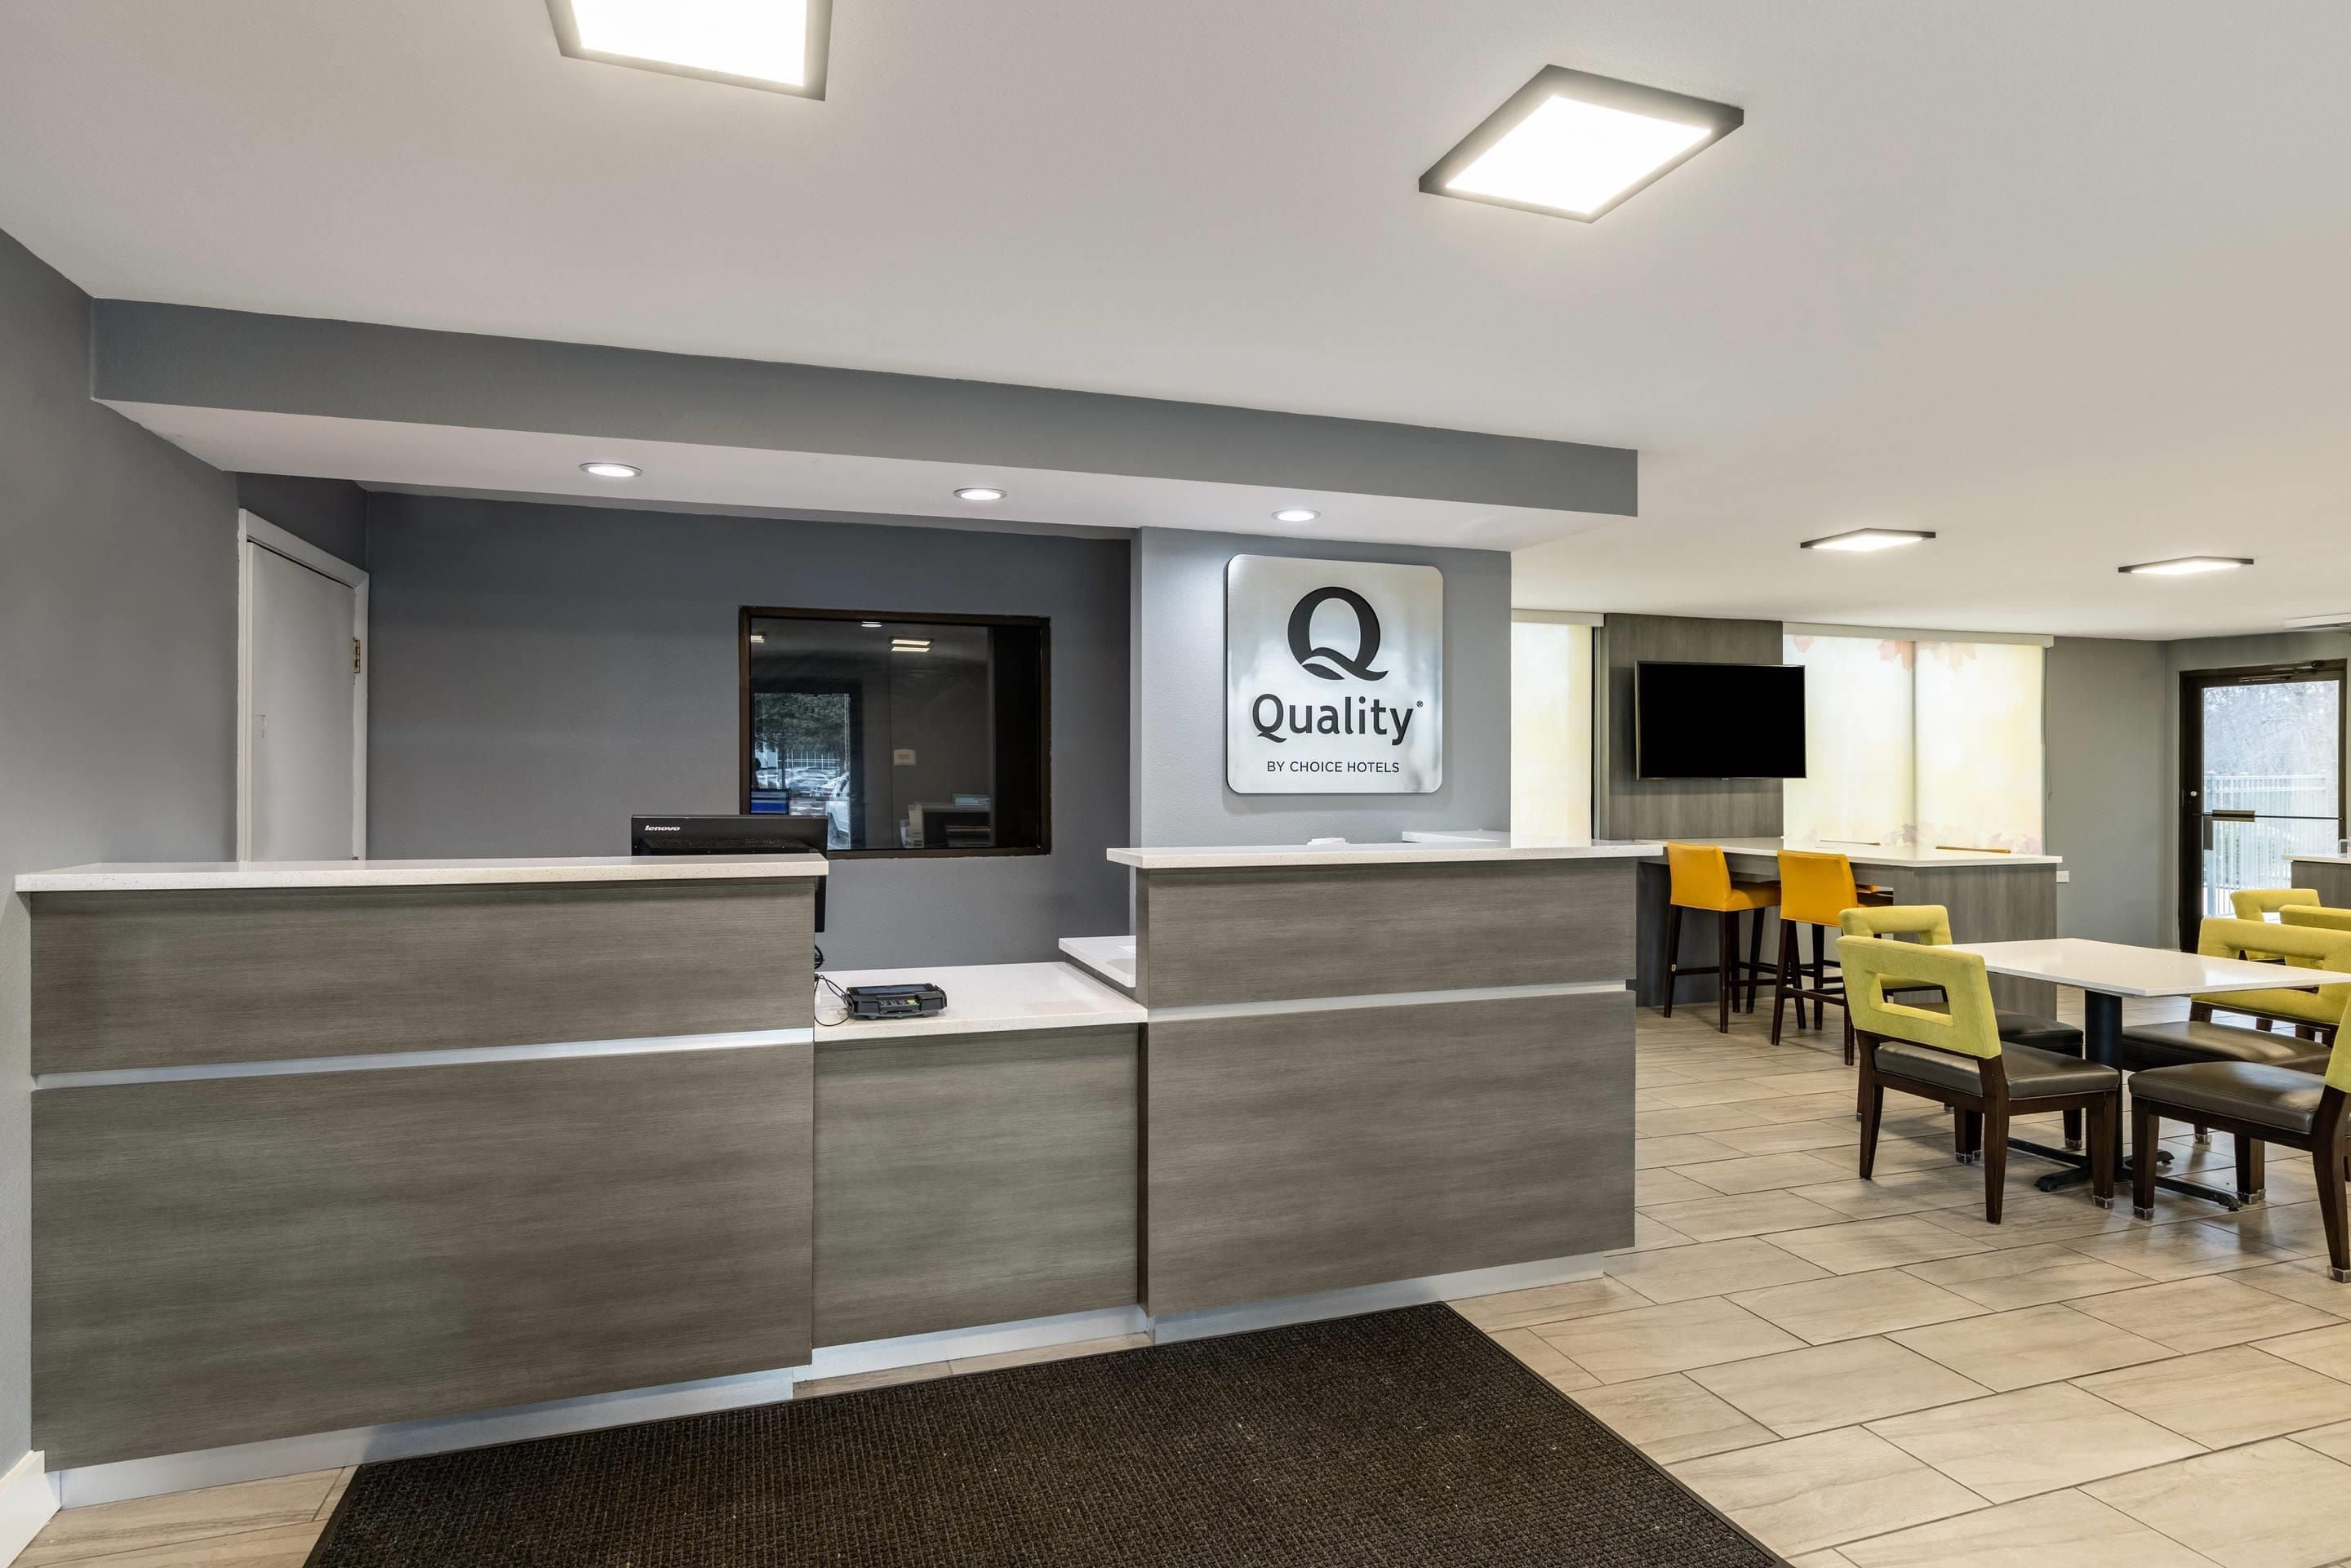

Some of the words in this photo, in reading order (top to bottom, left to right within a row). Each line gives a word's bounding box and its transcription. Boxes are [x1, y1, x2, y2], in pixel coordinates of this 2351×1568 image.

[1287, 586, 1389, 682] Q
[1267, 761, 1286, 772] BY
[1290, 761, 1343, 773] CHOICE
[1347, 762, 1400, 773] HOTELS
